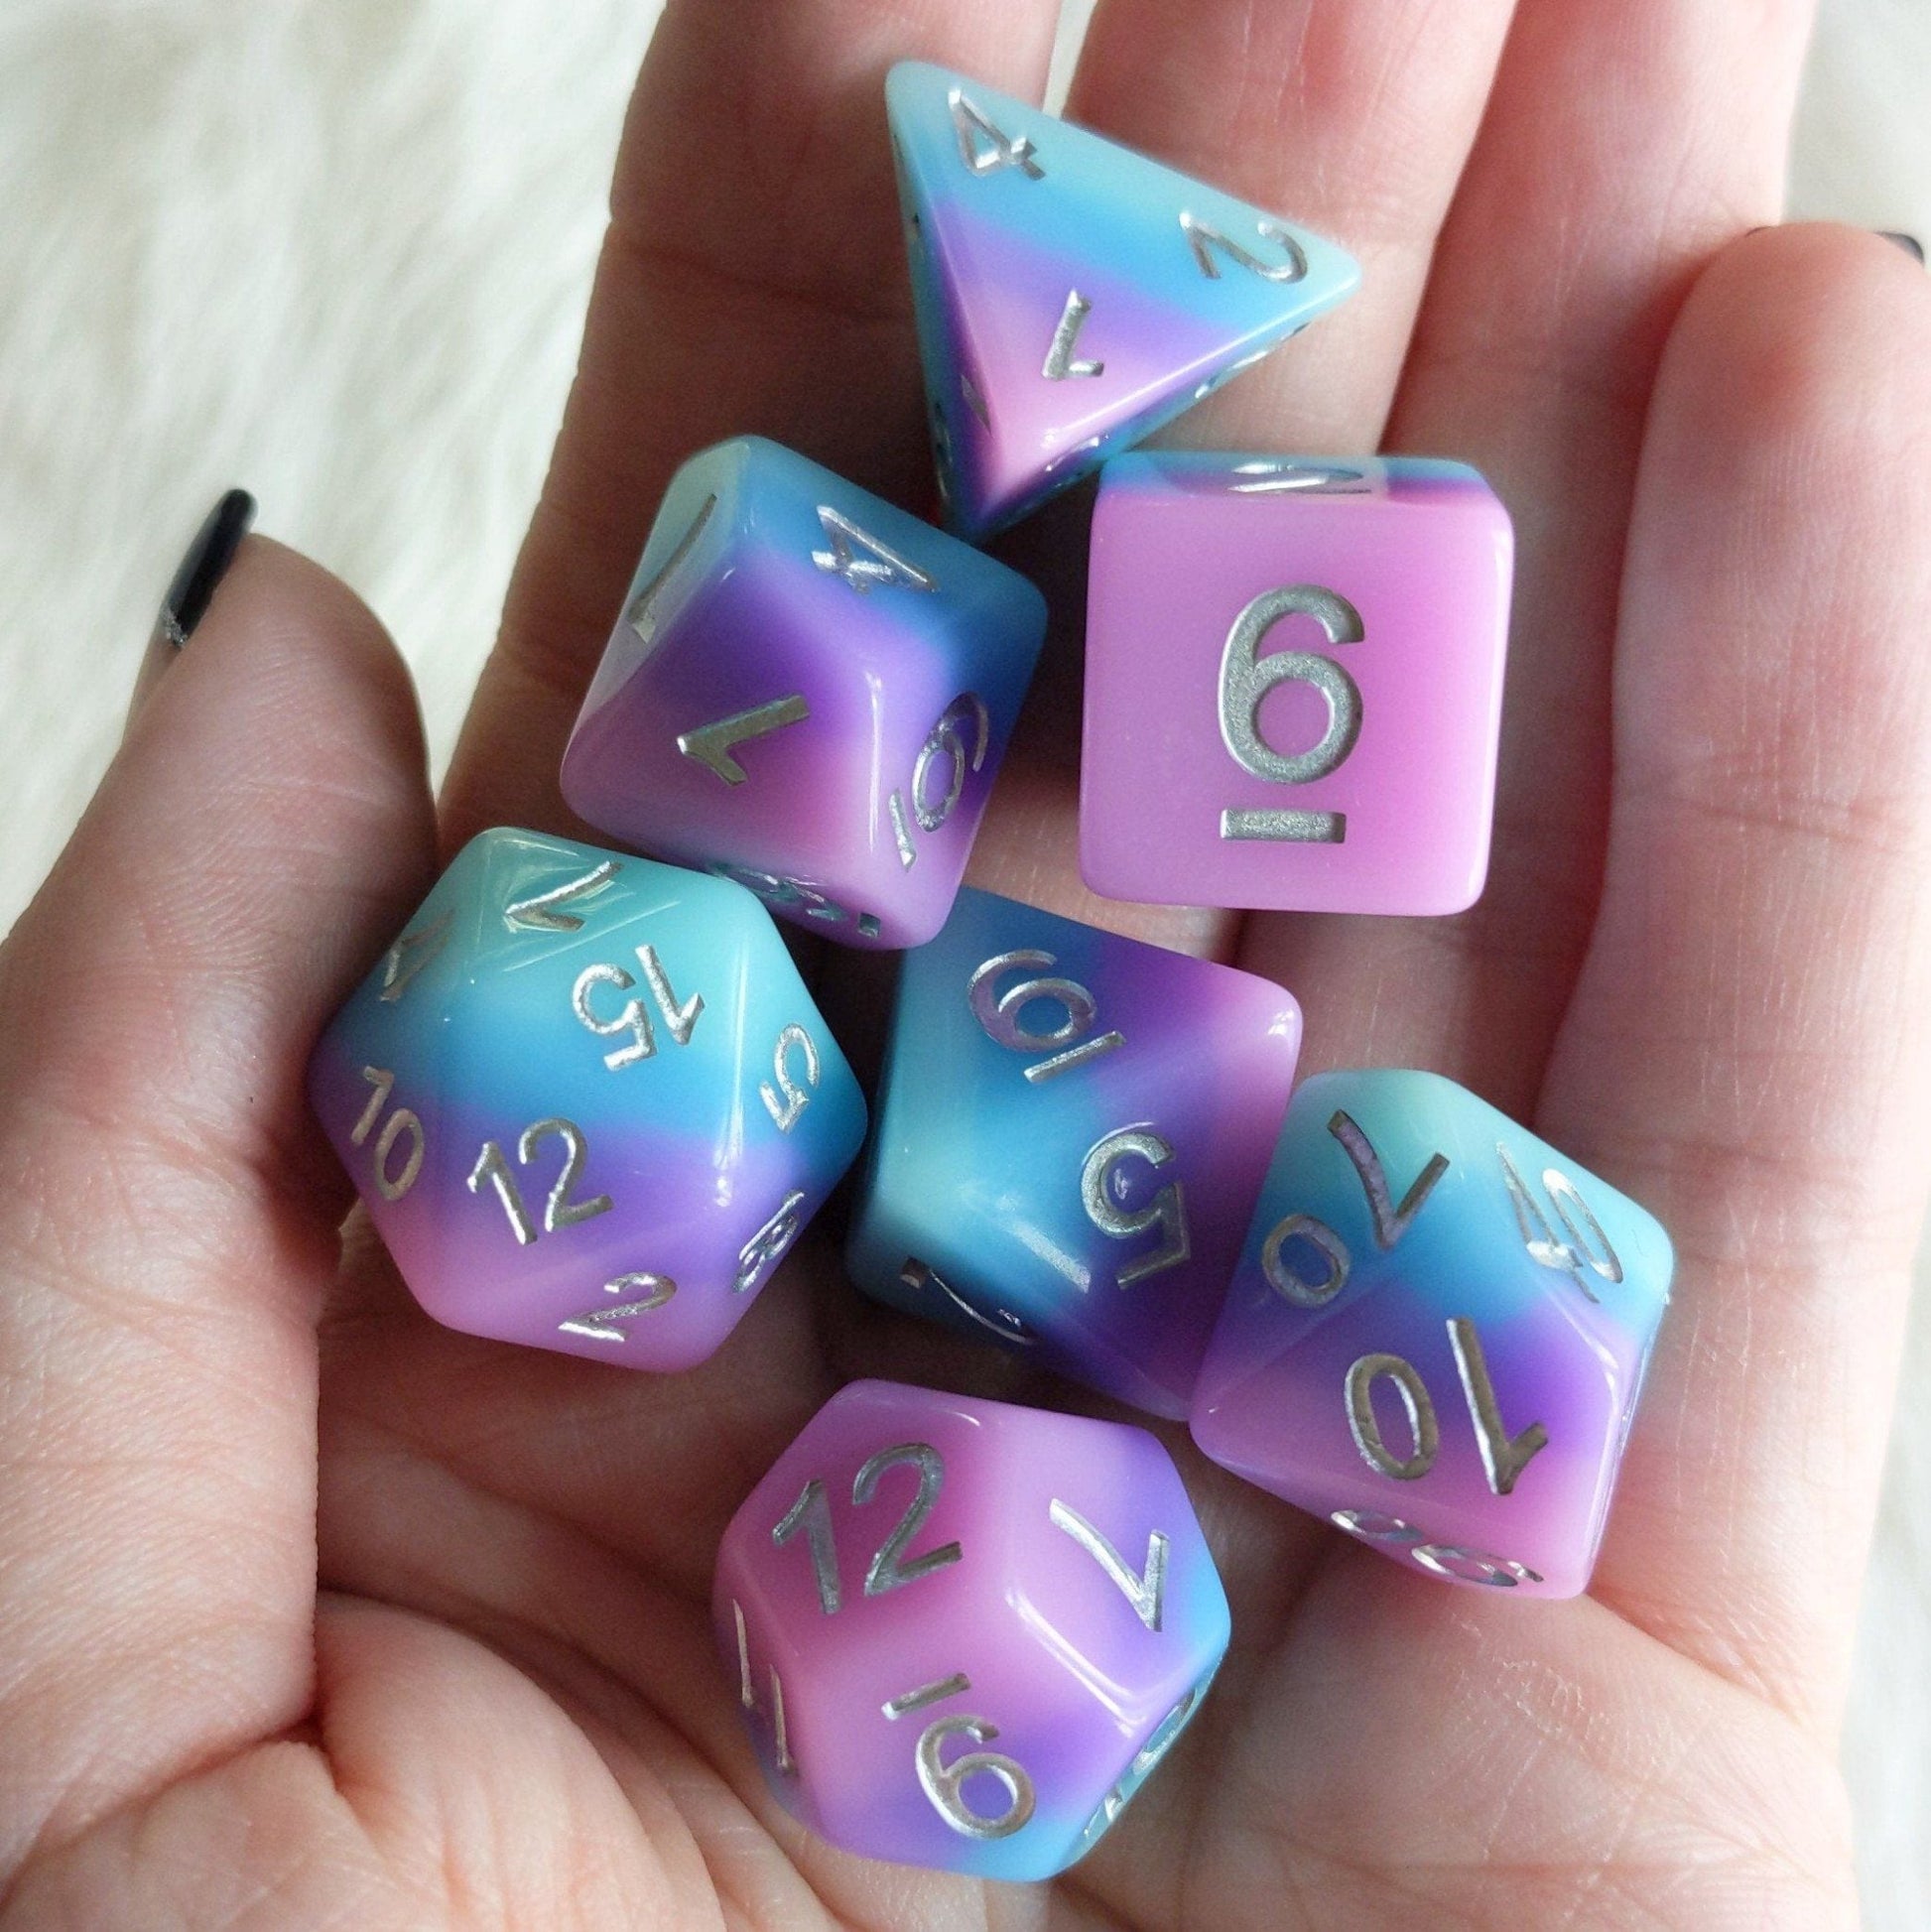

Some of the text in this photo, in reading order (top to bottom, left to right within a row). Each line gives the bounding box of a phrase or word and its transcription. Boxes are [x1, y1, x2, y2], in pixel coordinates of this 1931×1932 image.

[948, 85, 1046, 181] 4
[1178, 209, 1309, 284] 2
[1041, 287, 1104, 381] 1
[811, 504, 939, 596] 4
[1218, 583, 1365, 844] 6
[570, 944, 707, 1072] 15
[349, 1065, 426, 1202] 10
[760, 1023, 822, 1135] 5
[466, 1117, 615, 1246] 12
[1081, 1121, 1192, 1292] 5
[558, 1271, 679, 1343] 2
[1344, 1316, 1548, 1495] 10
[771, 1442, 965, 1615] 12
